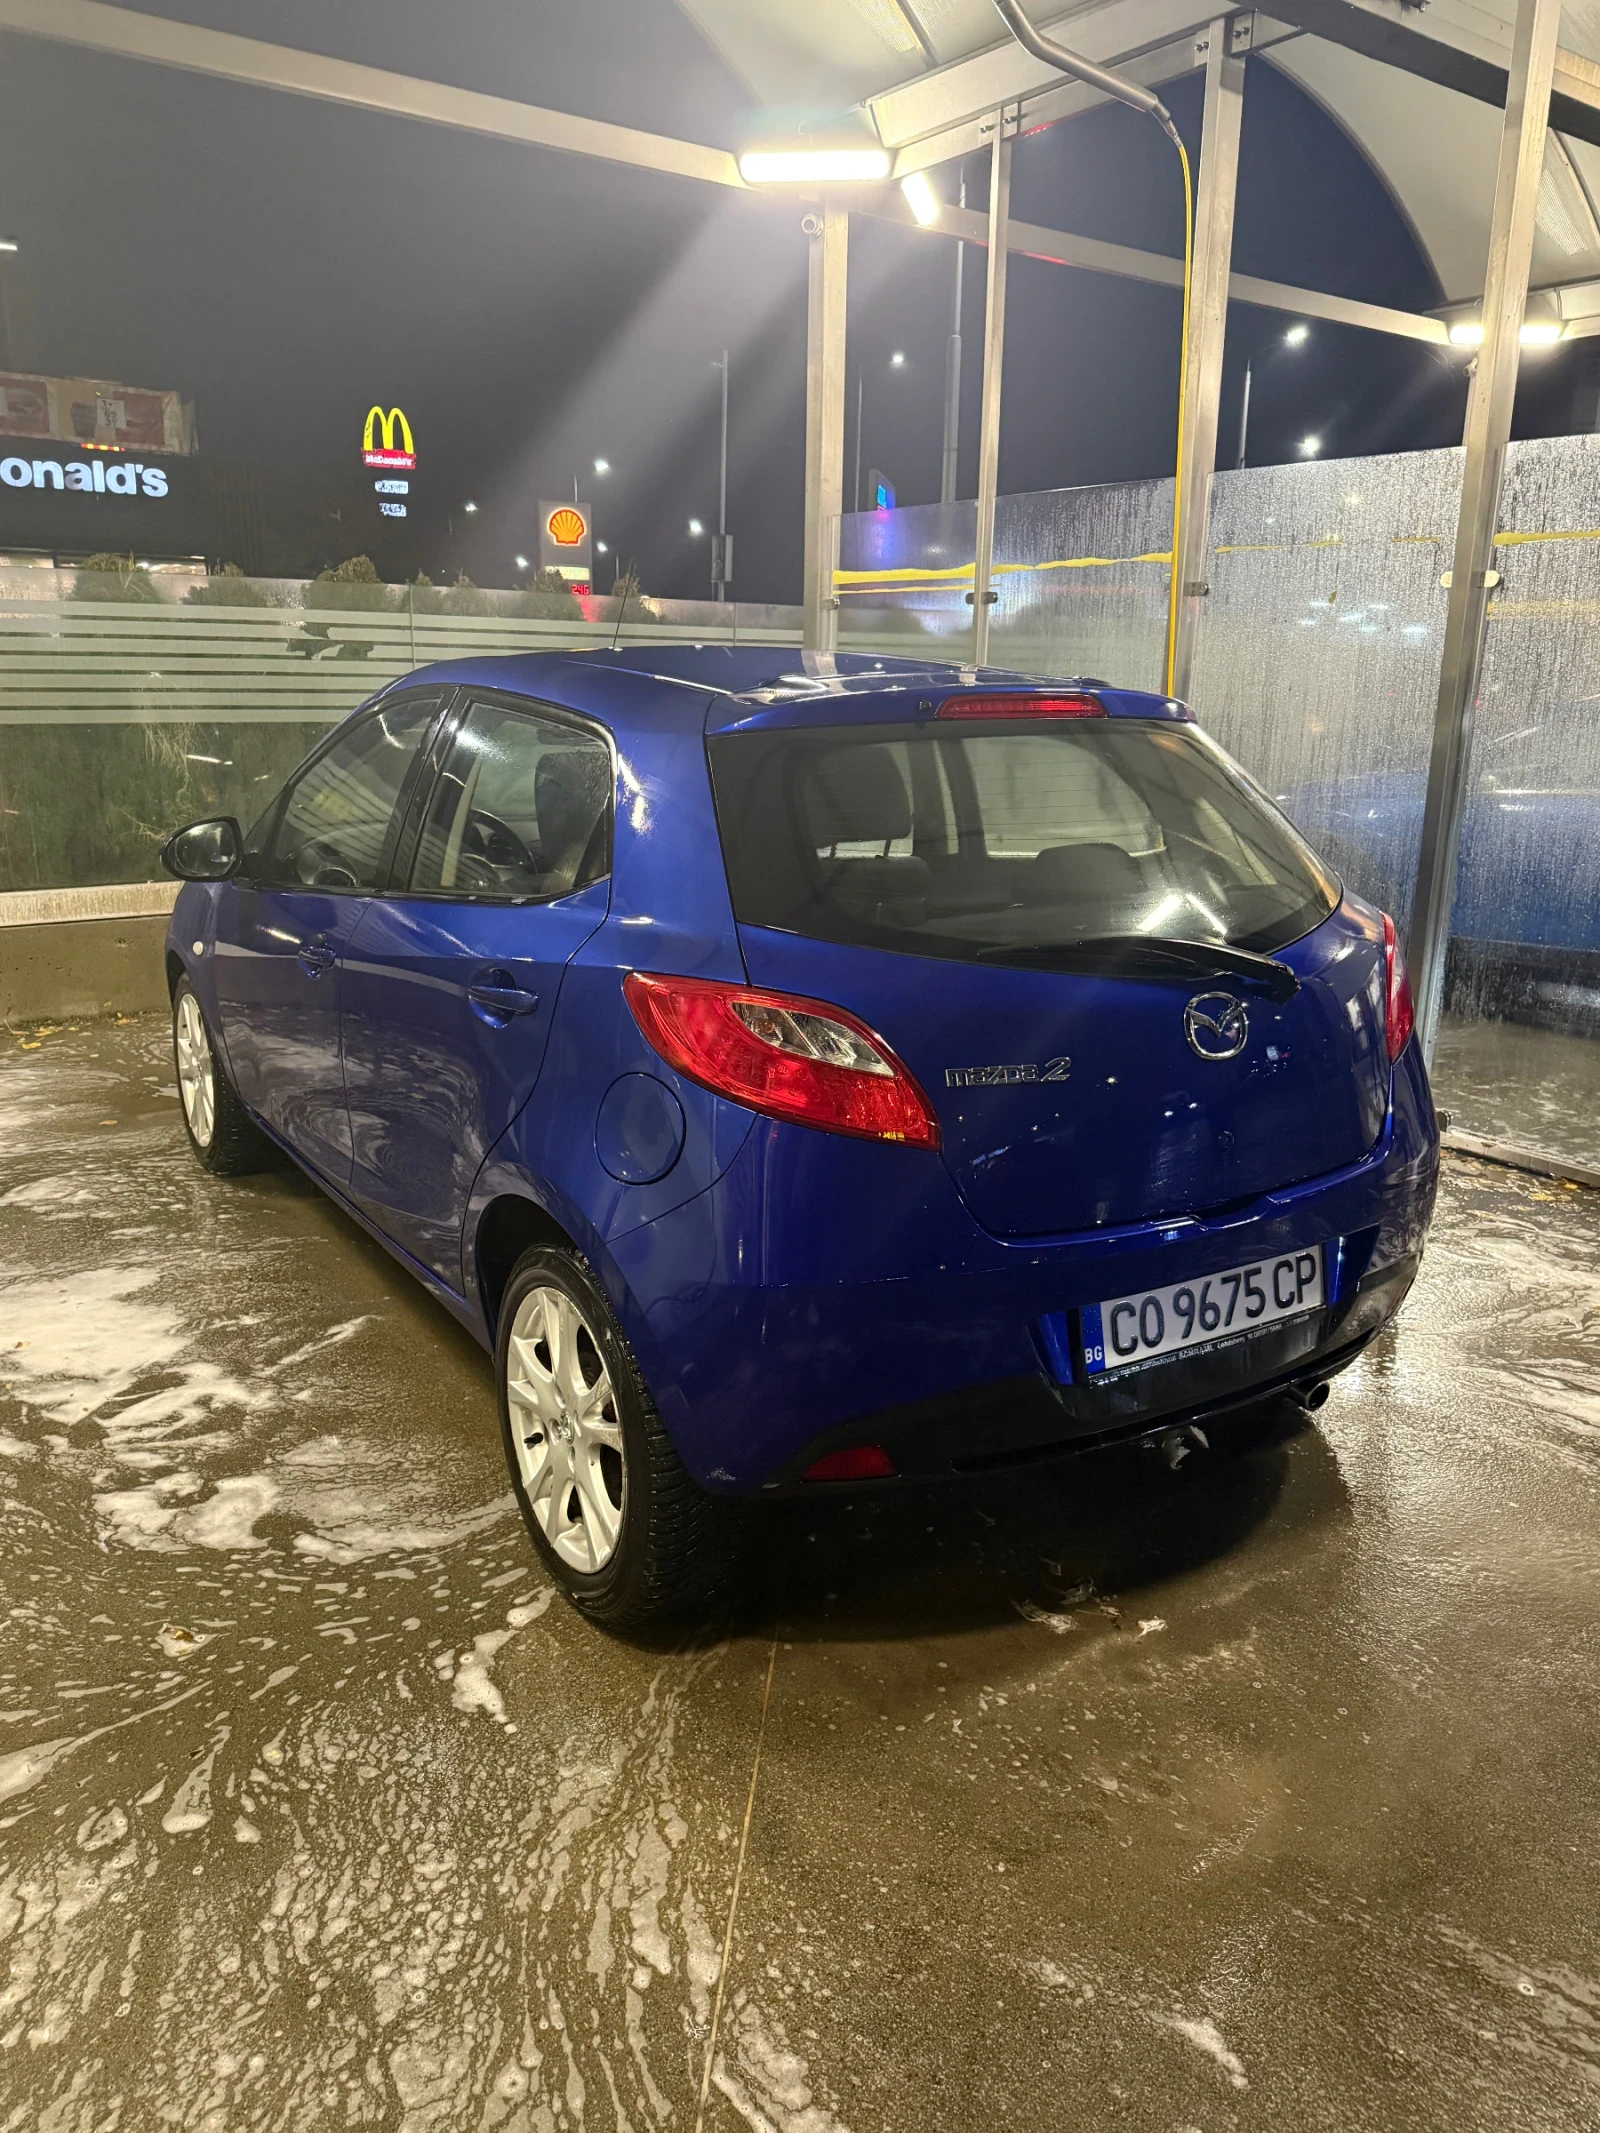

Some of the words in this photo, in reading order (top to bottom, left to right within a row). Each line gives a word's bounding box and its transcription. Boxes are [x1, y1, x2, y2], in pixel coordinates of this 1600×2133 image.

[1110, 1293, 1165, 1357] CO
[1172, 1266, 1267, 1340] 9675
[1272, 1251, 1317, 1310] CP
[1084, 1345, 1103, 1364] BG
